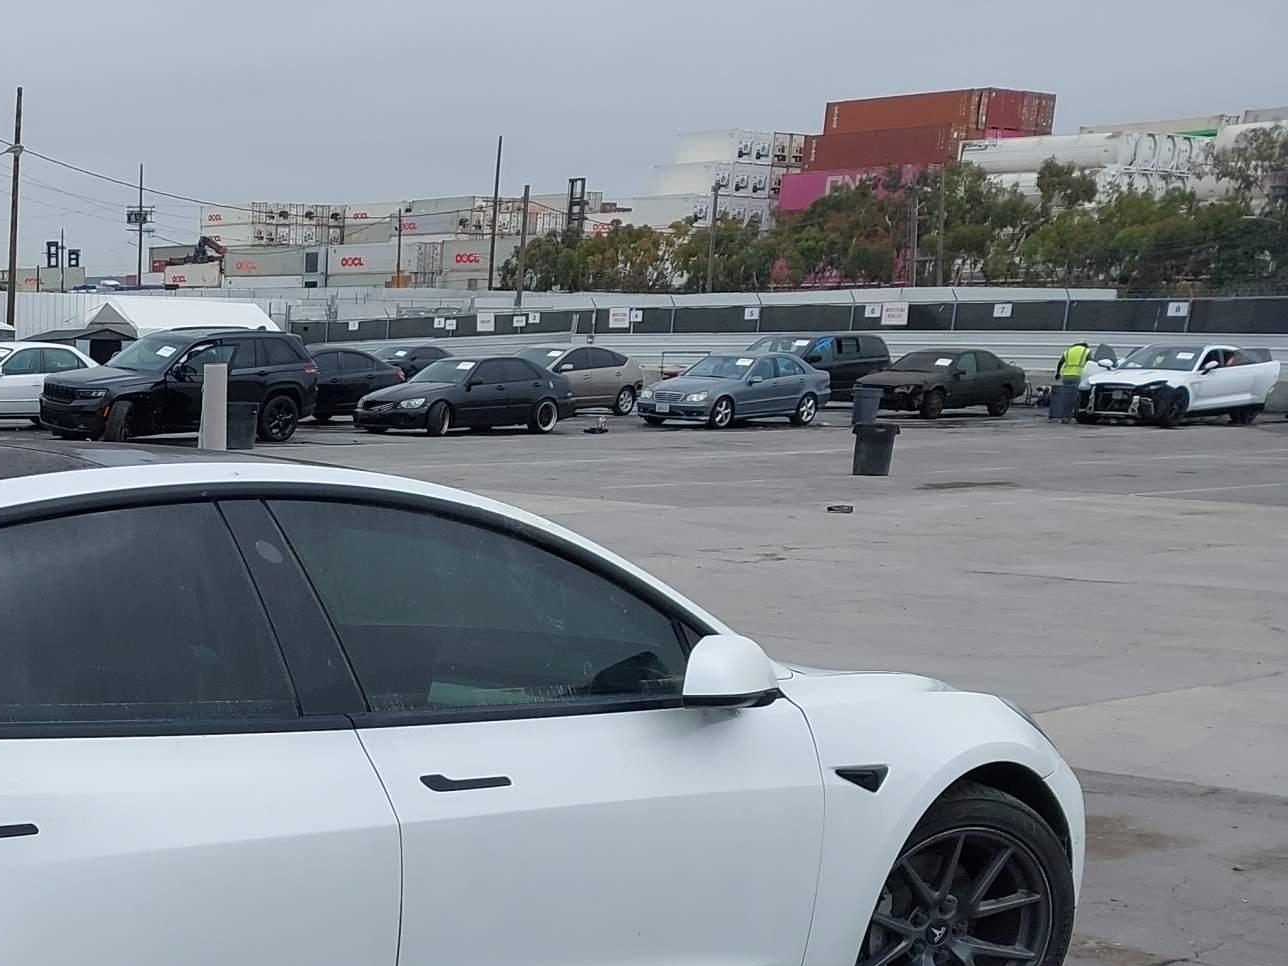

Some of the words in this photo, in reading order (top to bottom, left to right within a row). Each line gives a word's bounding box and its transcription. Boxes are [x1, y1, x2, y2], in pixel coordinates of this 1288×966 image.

[341, 256, 364, 267] OOCL
[456, 253, 480, 264] OOCL
[1000, 306, 1006, 314] 7
[1175, 304, 1181, 313] 8
